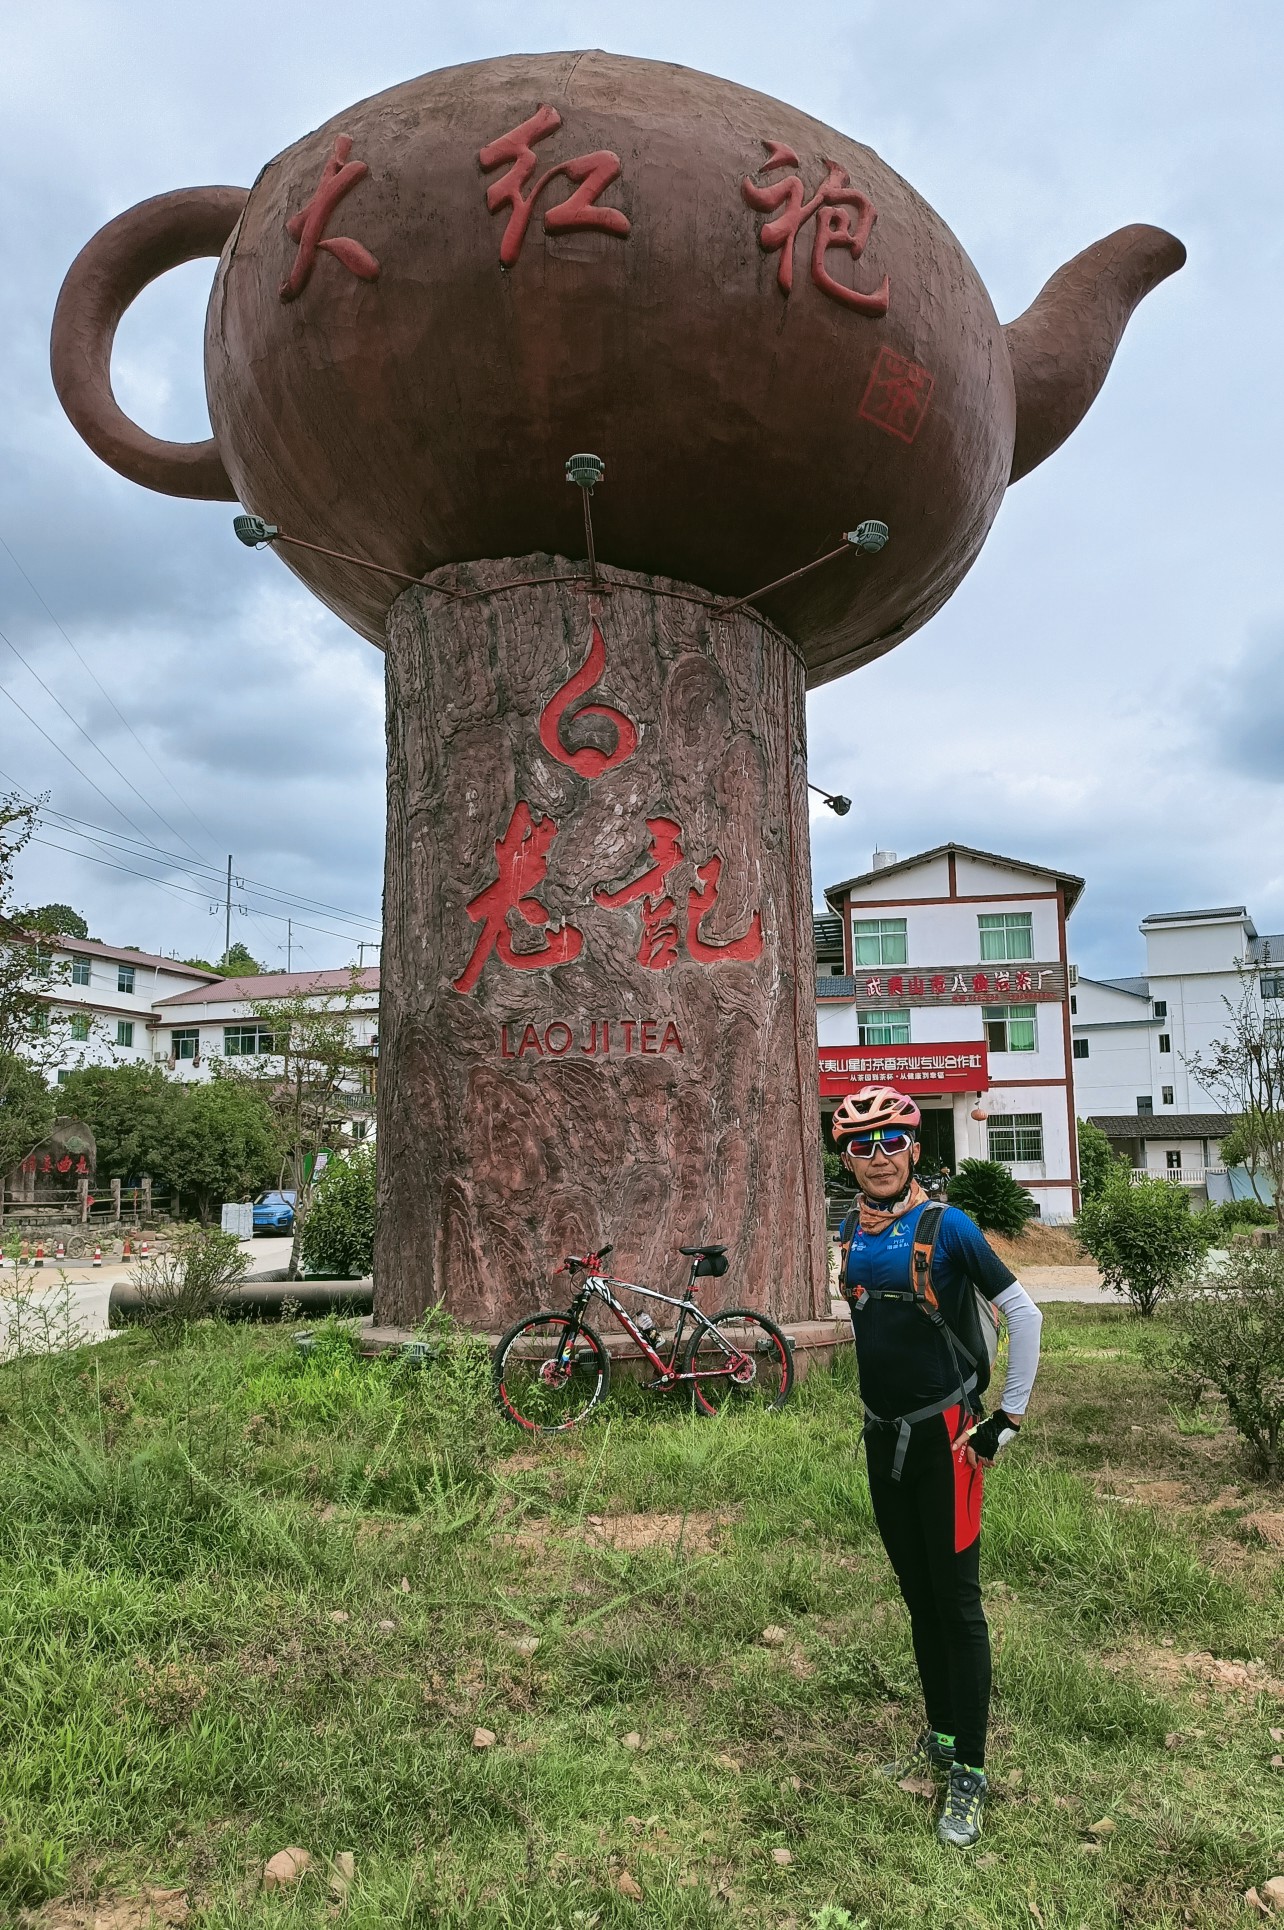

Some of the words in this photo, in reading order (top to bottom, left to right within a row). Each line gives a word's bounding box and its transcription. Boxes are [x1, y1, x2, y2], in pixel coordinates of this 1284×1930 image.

[501, 1021, 574, 1058] LAO
[579, 1020, 611, 1056] JI
[621, 1020, 684, 1055] TEA
